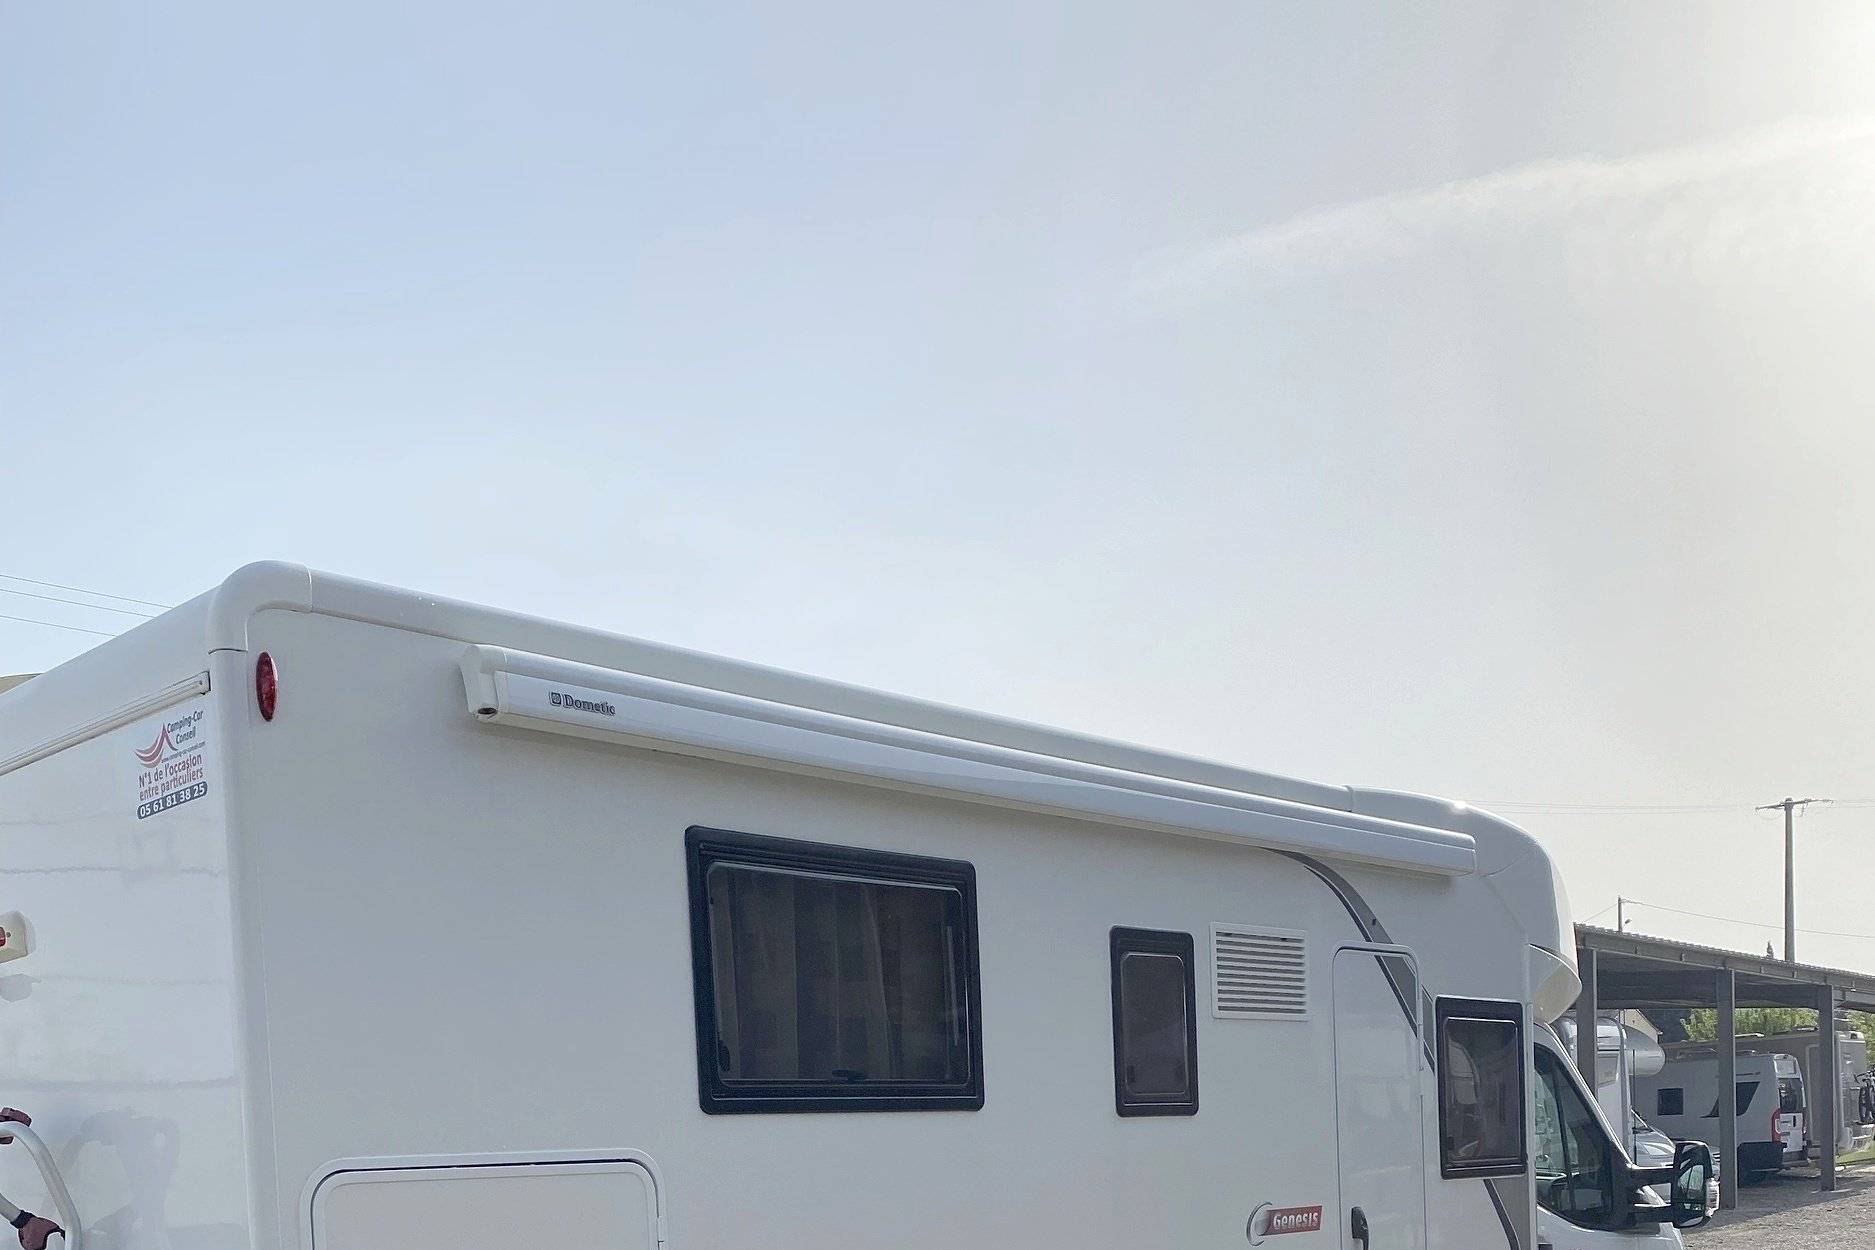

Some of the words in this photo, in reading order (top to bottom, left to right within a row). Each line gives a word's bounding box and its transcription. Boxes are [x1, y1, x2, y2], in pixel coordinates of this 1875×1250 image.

[563, 693, 616, 716] Dometic
[167, 711, 204, 733] Camping-Car
[176, 726, 197, 744] Conseil
[153, 767, 163, 782] de
[165, 754, 202, 777] l'occasion
[140, 785, 159, 801] entre
[161, 767, 203, 796] particuliers
[140, 804, 151, 817] 05
[153, 800, 164, 812] 61
[166, 794, 177, 807] 81
[180, 789, 191, 802] 38
[193, 783, 205, 797] 25
[1273, 1212, 1319, 1231] Genesis
